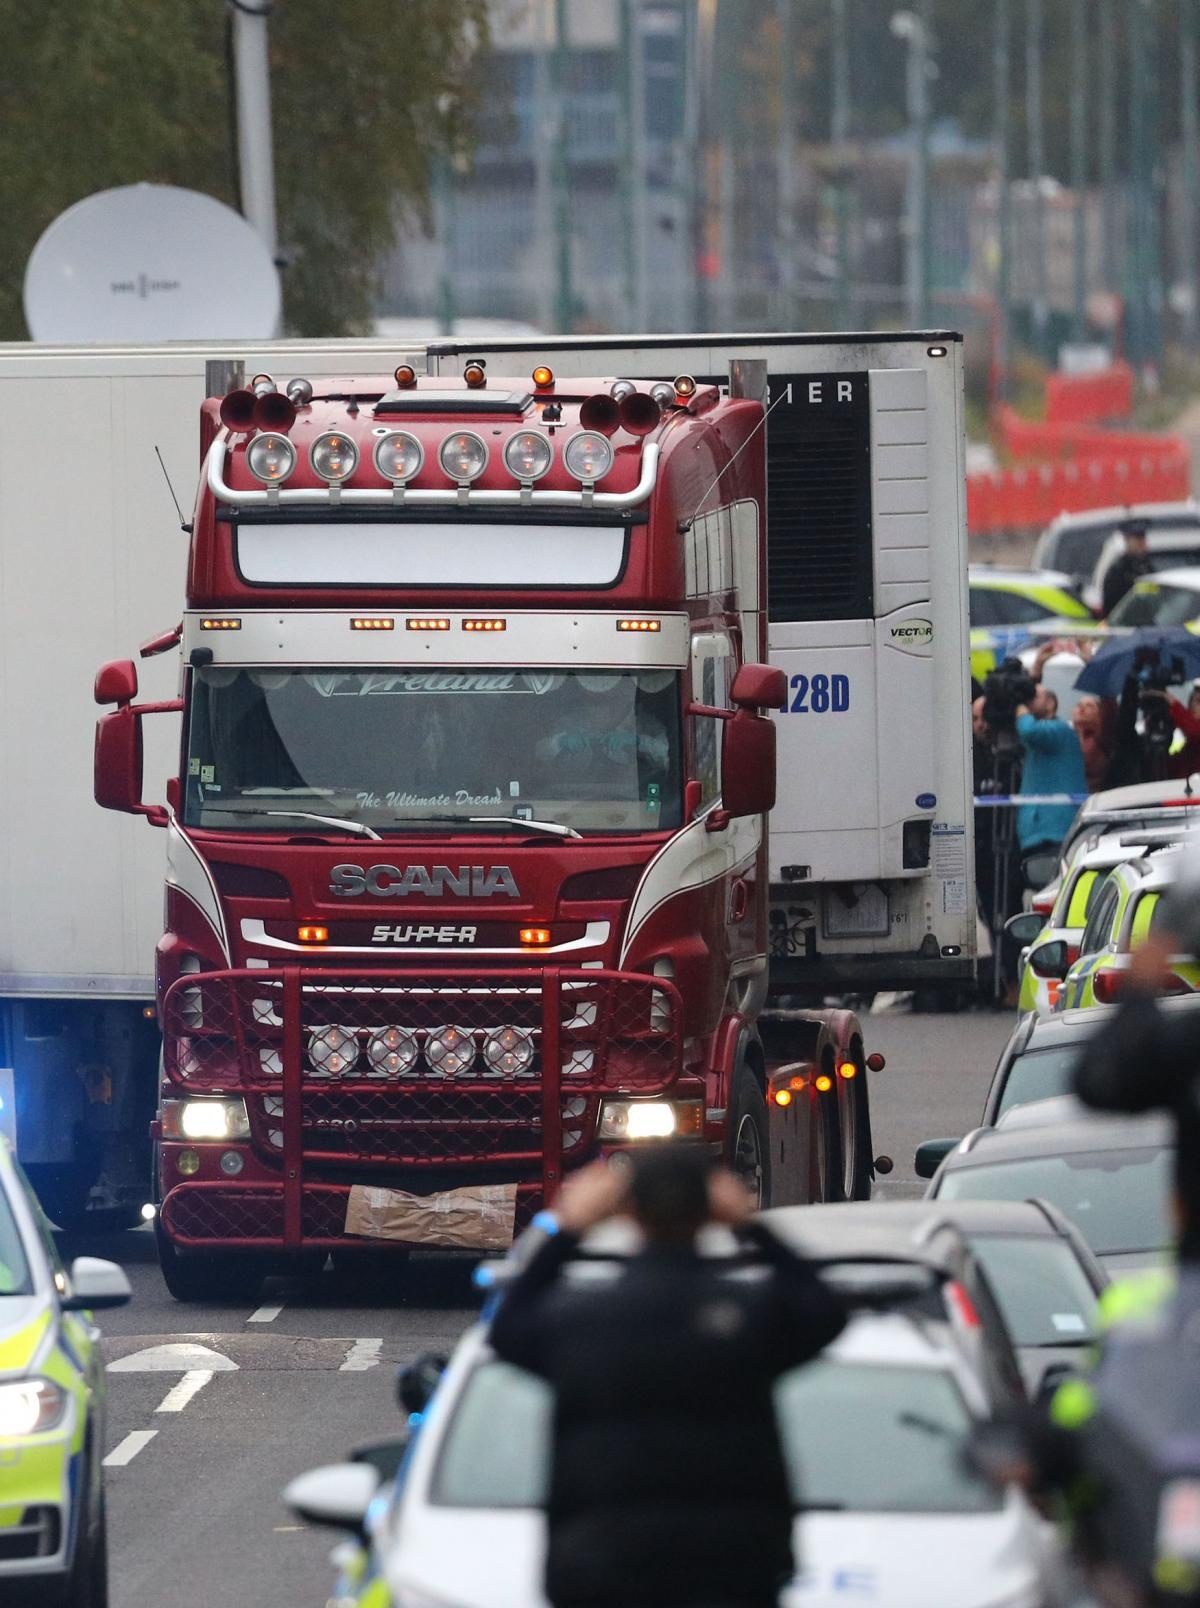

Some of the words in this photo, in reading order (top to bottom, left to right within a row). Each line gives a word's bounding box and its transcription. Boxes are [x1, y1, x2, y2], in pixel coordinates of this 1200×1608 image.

[891, 627, 932, 637] VECTOR
[356, 792, 381, 809] The
[386, 791, 450, 808] Ultimate
[455, 788, 503, 807] Dream
[329, 864, 521, 897] SCANIA
[371, 926, 478, 943] SUPER
